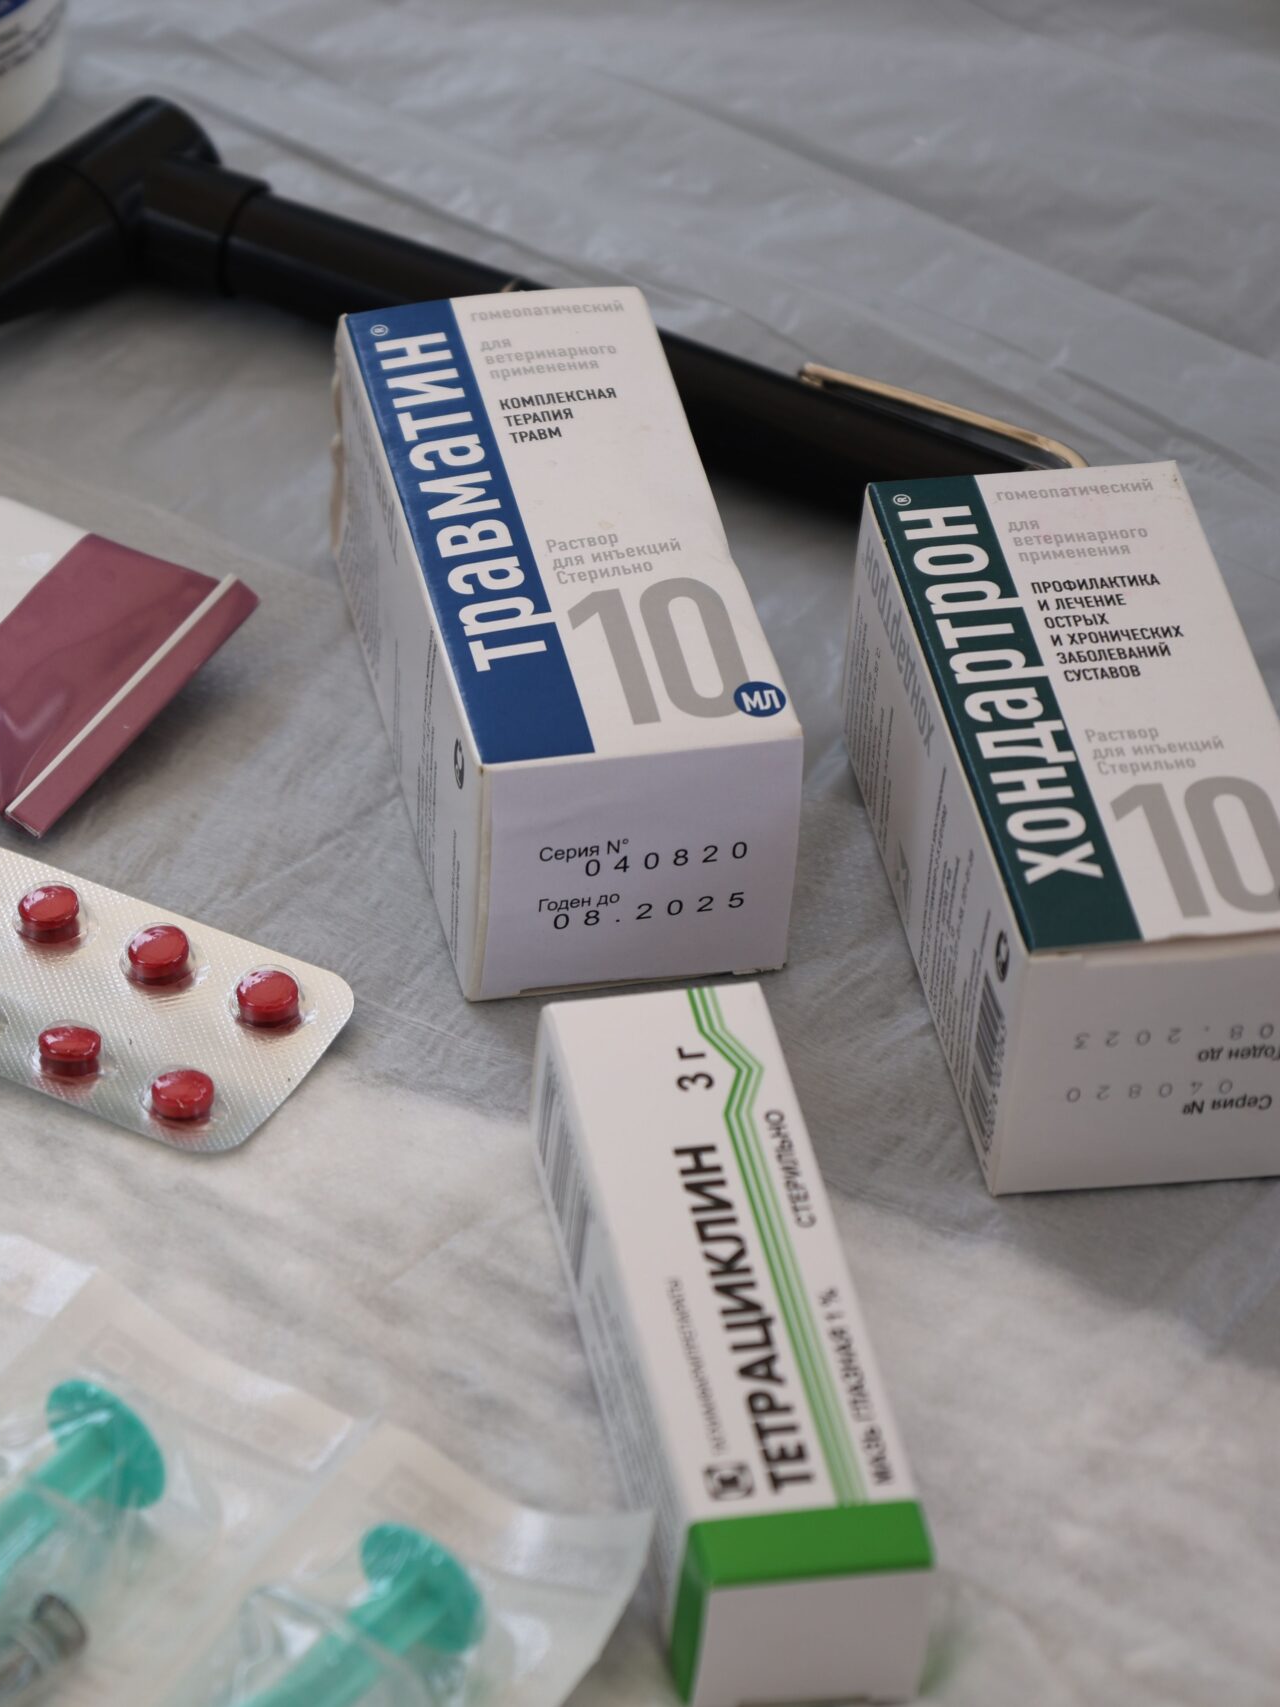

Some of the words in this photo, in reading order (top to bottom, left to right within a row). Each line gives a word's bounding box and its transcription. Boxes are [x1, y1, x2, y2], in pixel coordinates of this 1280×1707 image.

[469, 299, 625, 323] гомеопатический
[479, 337, 512, 353] для
[485, 343, 618, 366] ветеринарного
[489, 357, 600, 381] применения
[498, 386, 618, 411] КОМПЛЕКСНАЯ
[504, 407, 574, 428] ТЕРАПИЯ
[509, 426, 563, 444] ТРАВМ
[995, 478, 1154, 503] гомеопатический
[1008, 518, 1040, 534] для
[1013, 526, 1149, 548] ветеринарного
[545, 532, 620, 554] Раствор
[1018, 543, 1131, 565] применения
[552, 555, 586, 572] для
[589, 537, 683, 563] инъекций
[556, 560, 655, 586] Стерильно
[1030, 573, 1161, 595] ПРОФИЛАКТИКА
[1037, 599, 1051, 612] И
[1054, 593, 1127, 611] ЛЕЧЕНИЕ
[1043, 612, 1110, 630] ОСТРЫХ
[1049, 633, 1064, 647] И
[1068, 625, 1184, 646] ХРОНИЧЕСКИХ
[567, 577, 750, 726] 10
[1056, 642, 1173, 665] ЗАБОЛЕВАНИЙ
[1063, 664, 1142, 683] СУСТАВОВ
[1084, 726, 1160, 744] Раствор
[1092, 748, 1126, 760] для
[1131, 736, 1226, 757] инъекций
[1096, 755, 1197, 776] Стерильно
[539, 845, 600, 863] Серия
[1109, 775, 1280, 920] 10
[584, 841, 748, 877] 040820
[538, 893, 592, 912] Годен
[597, 892, 620, 907] до
[1197, 1046, 1223, 1062] до
[676, 1071, 715, 1092] 3
[1210, 1093, 1273, 1111] Серия
[765, 1109, 817, 1229] СТЕРИЛЬНО
[674, 1144, 815, 1495] ТЕТРАЦИКЛИН
[862, 1424, 895, 1487] МАЗЬ
